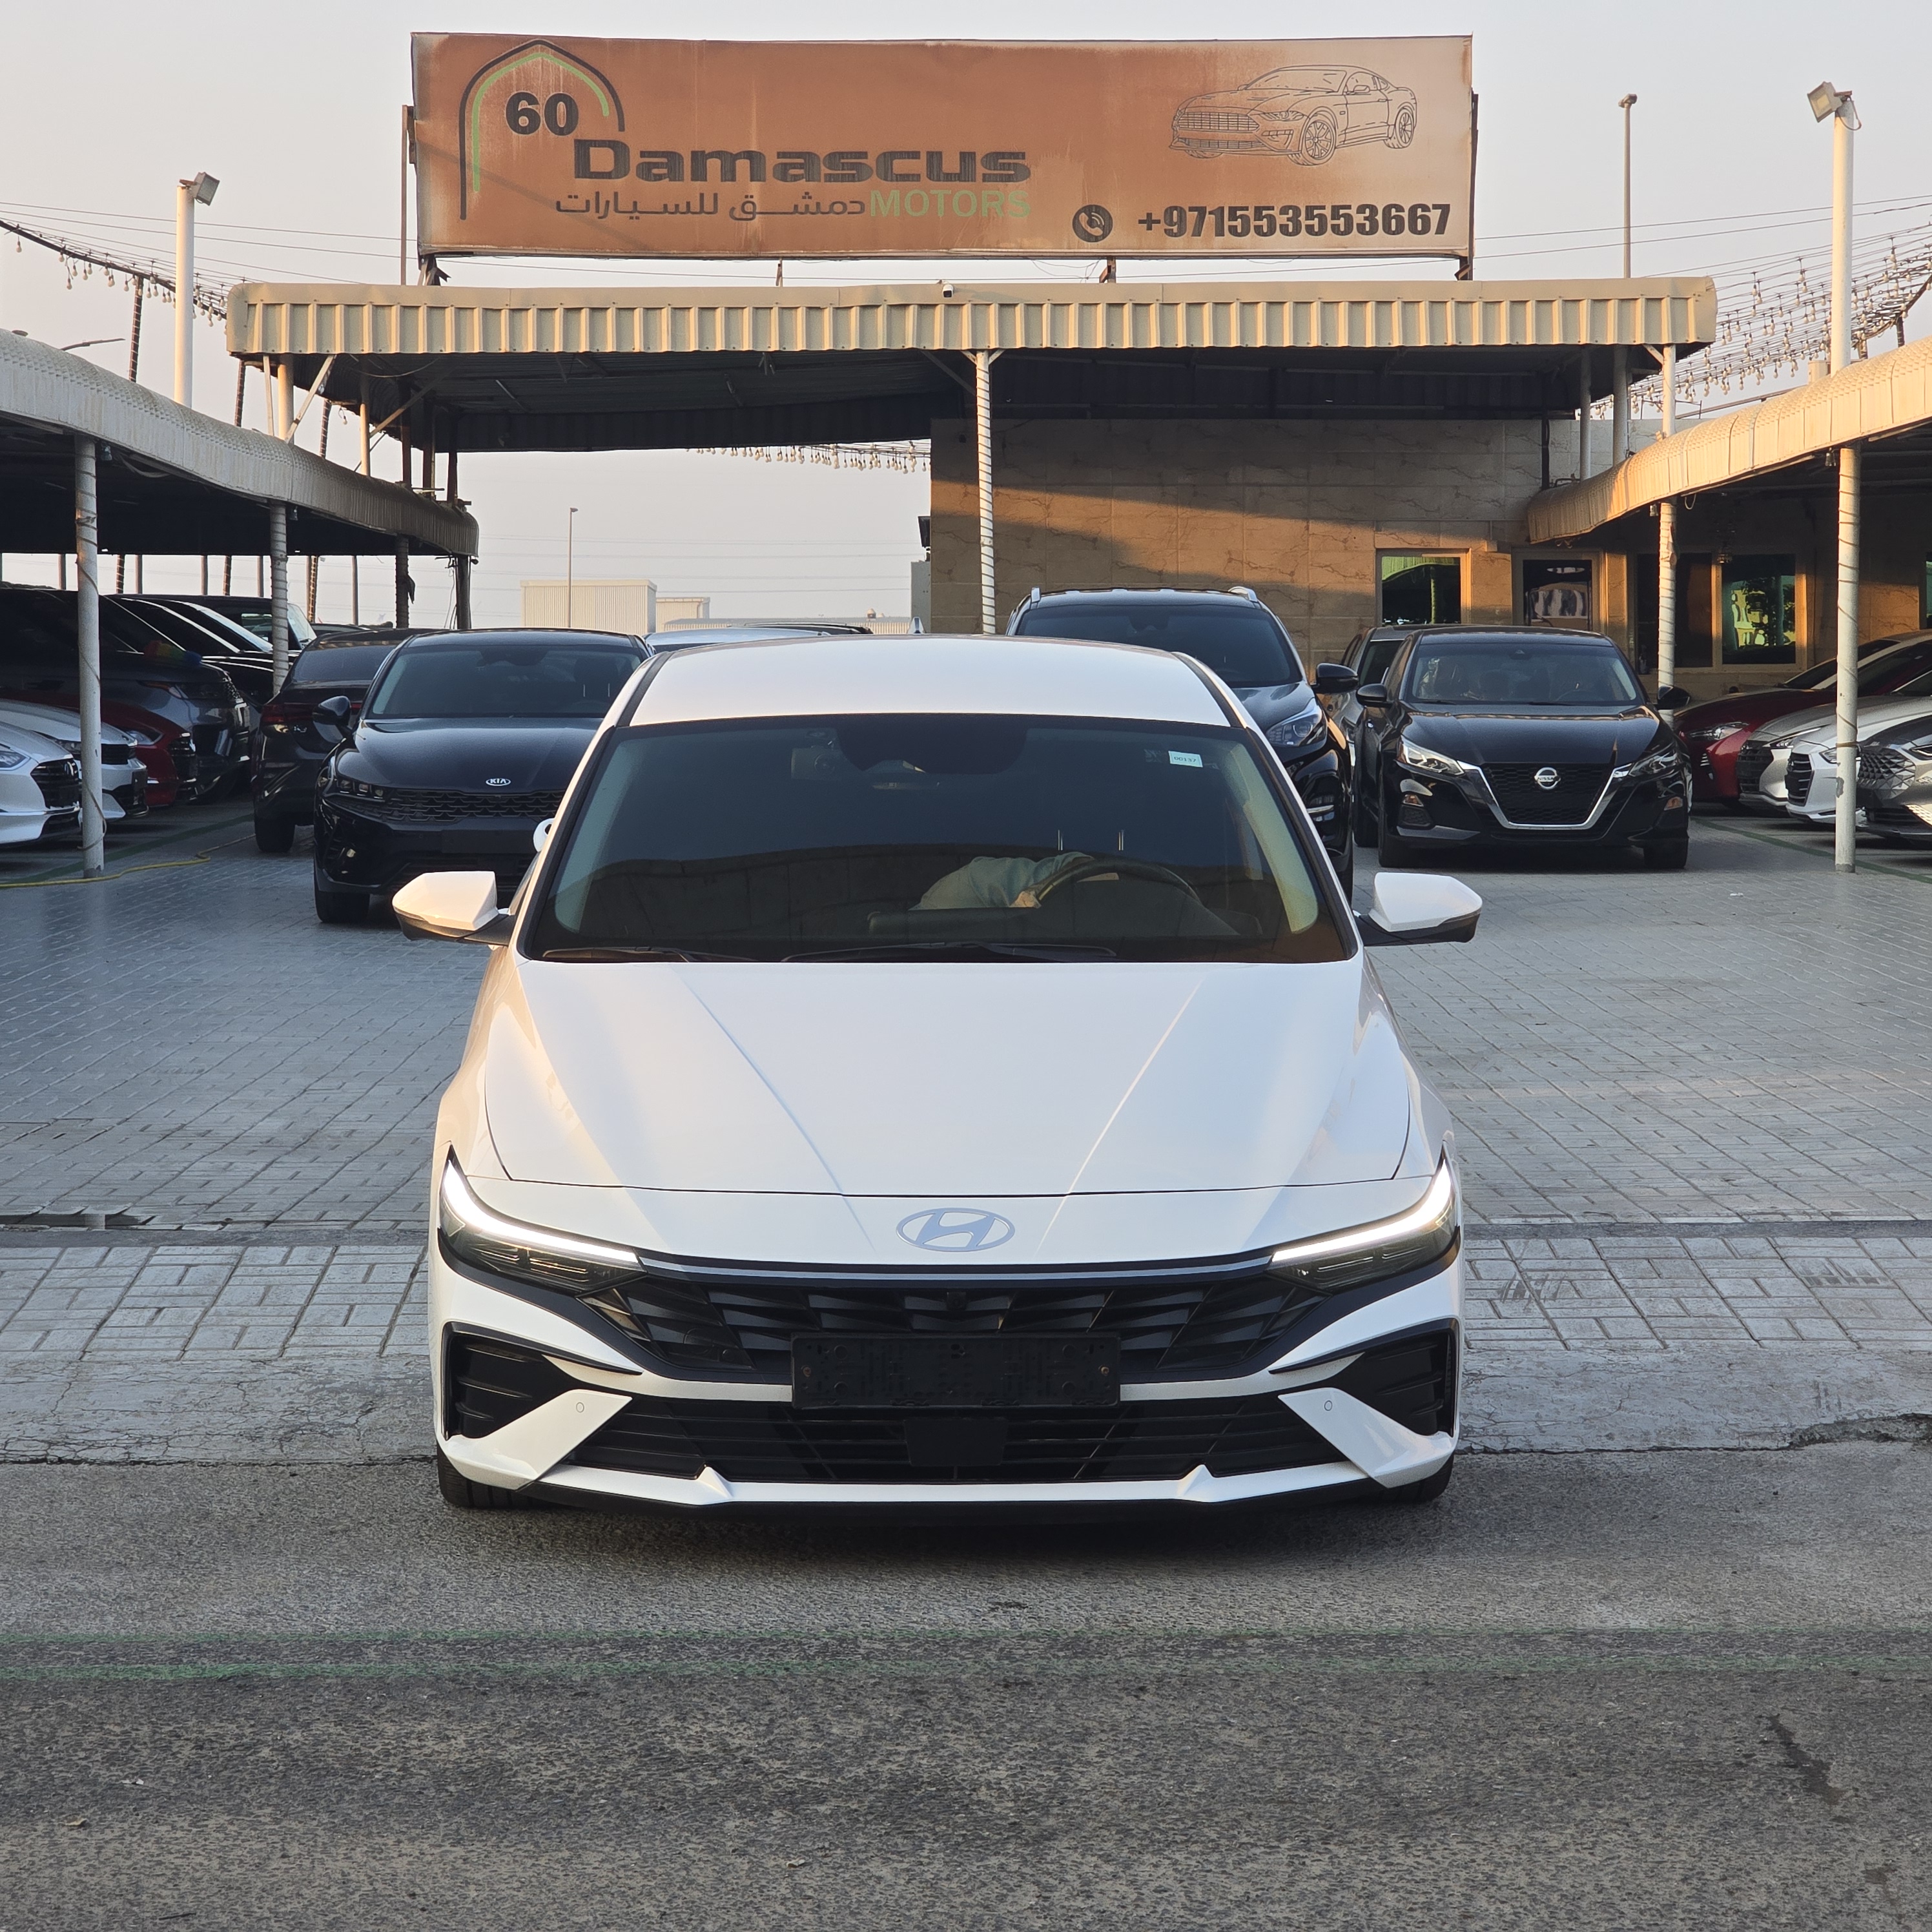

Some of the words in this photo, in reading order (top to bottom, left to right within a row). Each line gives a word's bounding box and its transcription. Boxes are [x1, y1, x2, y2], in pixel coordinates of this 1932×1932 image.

[506, 92, 579, 136] 60
[574, 139, 1031, 183] Damascus
[556, 192, 718, 220] للسيارات
[870, 190, 1032, 218] MOTORS
[1138, 203, 1450, 238] +971553553667
